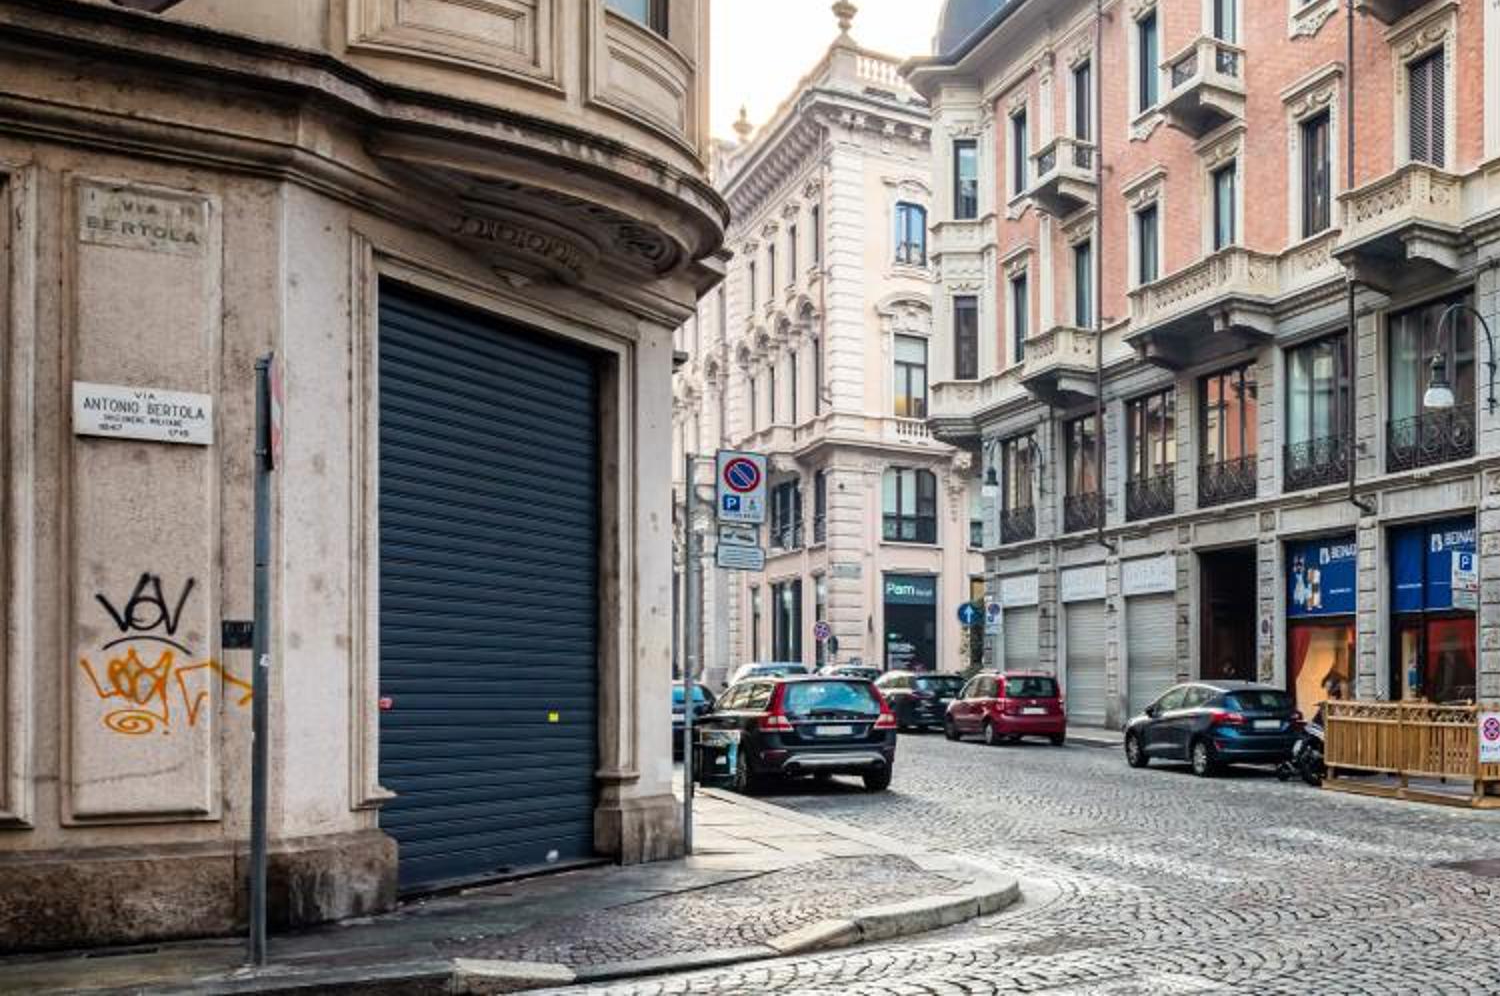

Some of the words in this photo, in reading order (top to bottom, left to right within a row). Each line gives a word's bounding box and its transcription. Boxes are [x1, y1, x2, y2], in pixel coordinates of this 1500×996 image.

[86, 215, 200, 245] BERTOLA
[134, 391, 156, 400] VIA
[83, 396, 139, 414] ANTONIO
[147, 403, 205, 420] BERTOLA
[726, 497, 737, 509] P
[1461, 555, 1470, 569] P
[886, 582, 915, 597] Pam
